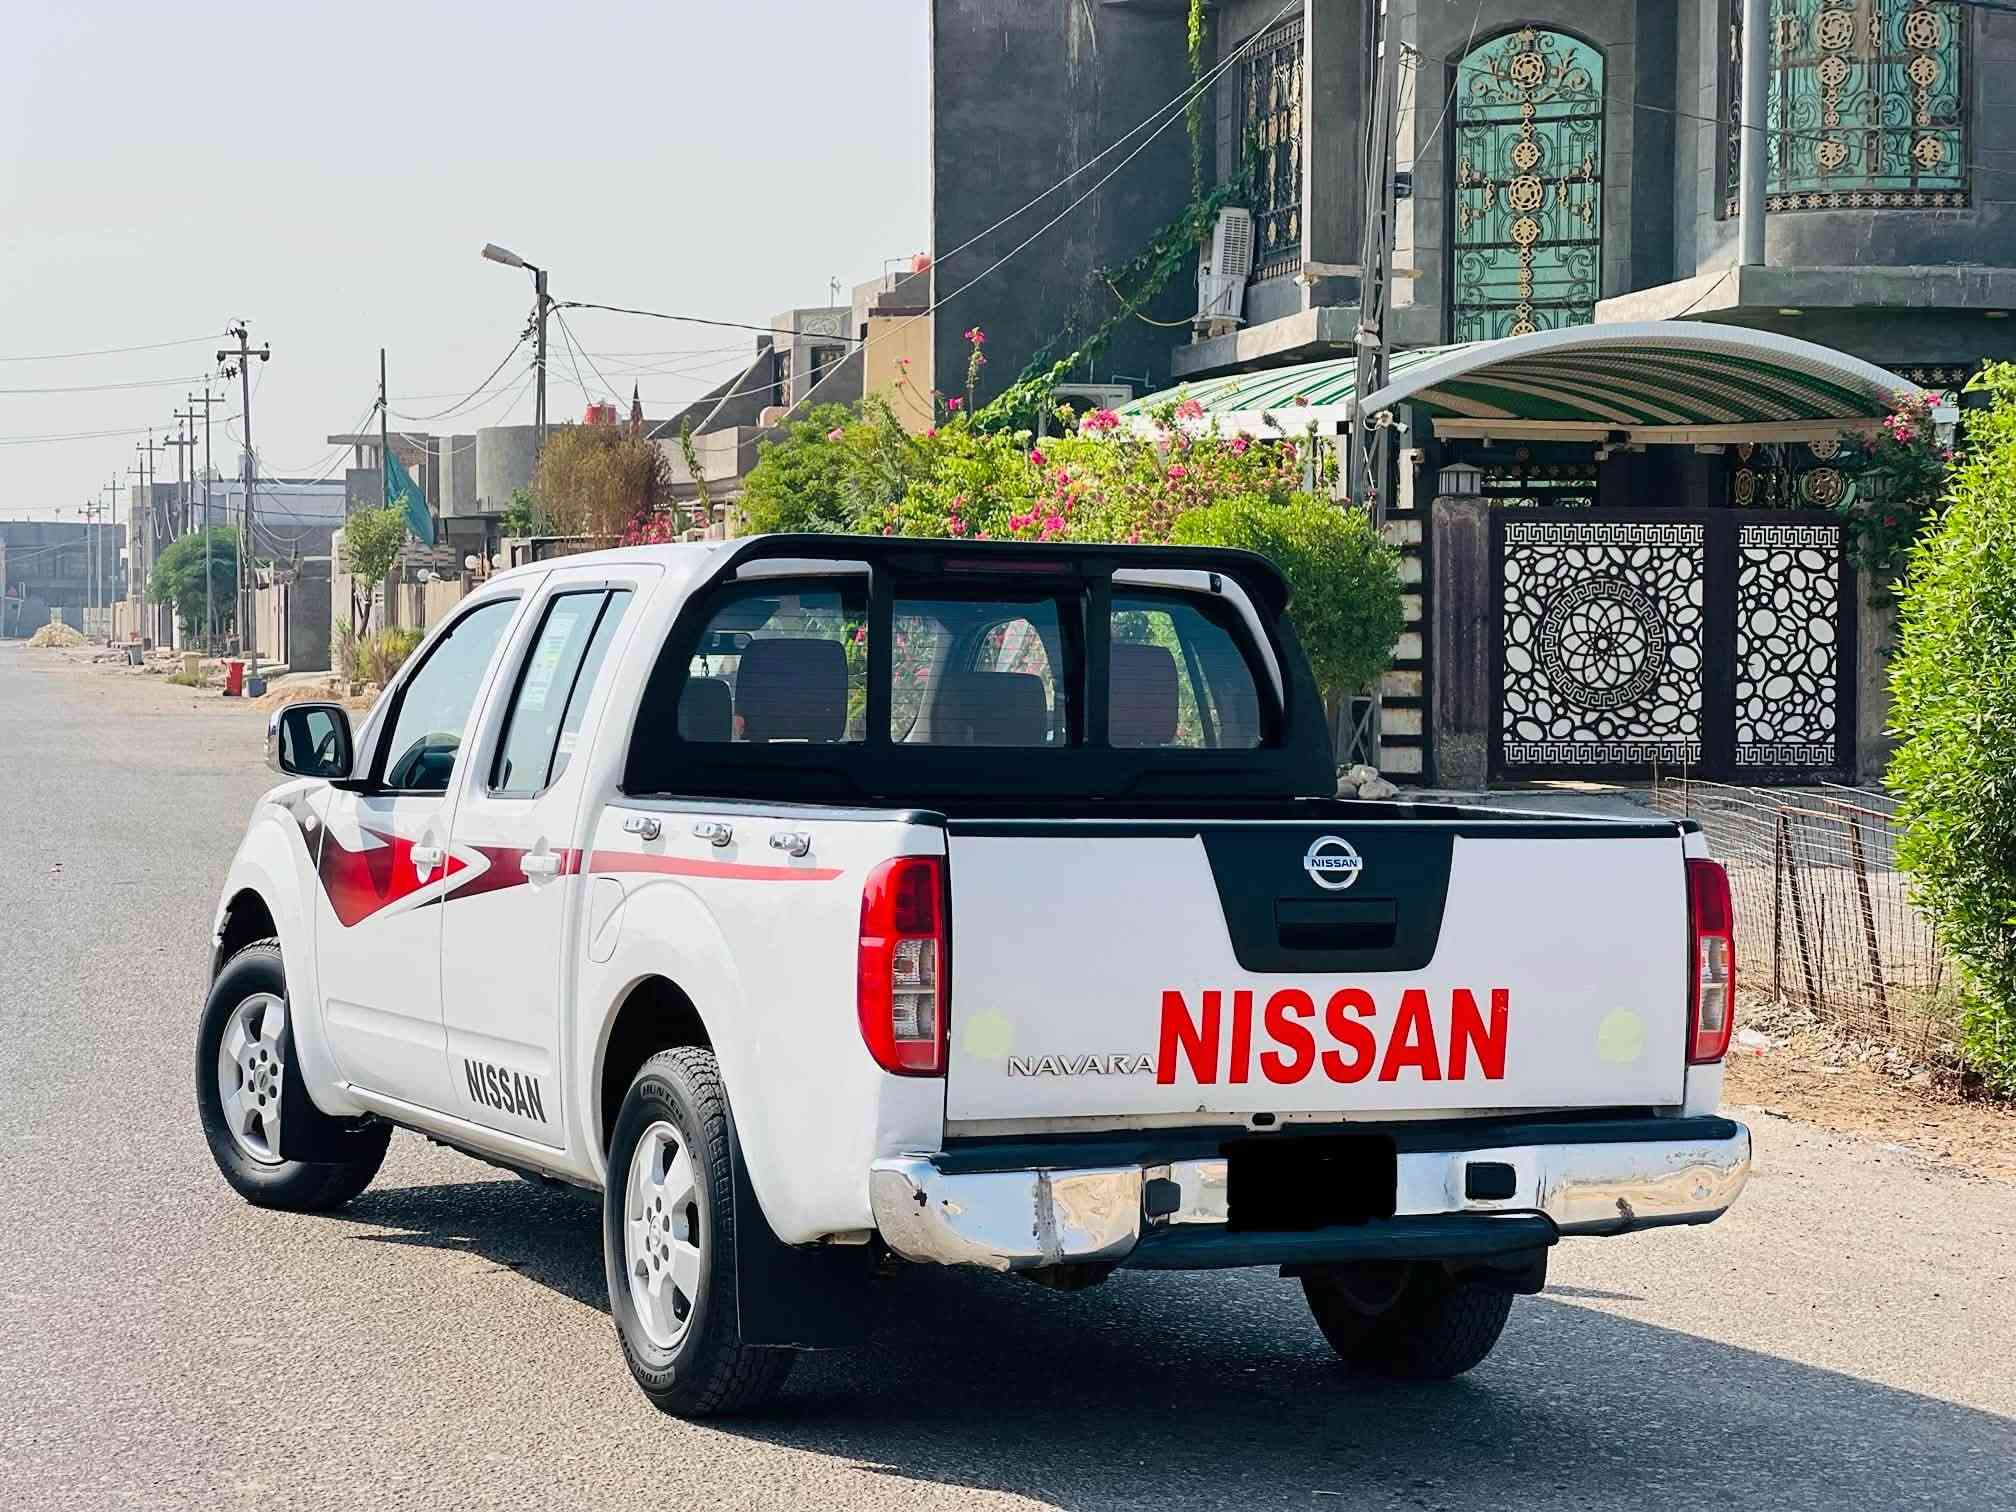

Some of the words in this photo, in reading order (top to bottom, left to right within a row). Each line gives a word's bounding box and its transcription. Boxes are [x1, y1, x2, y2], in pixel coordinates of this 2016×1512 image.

[1311, 858, 1358, 868] NISSAN
[1156, 988, 1510, 1085] NISSAN
[1008, 1054, 1158, 1077] NAVARA
[464, 1058, 547, 1124] NISSAN
